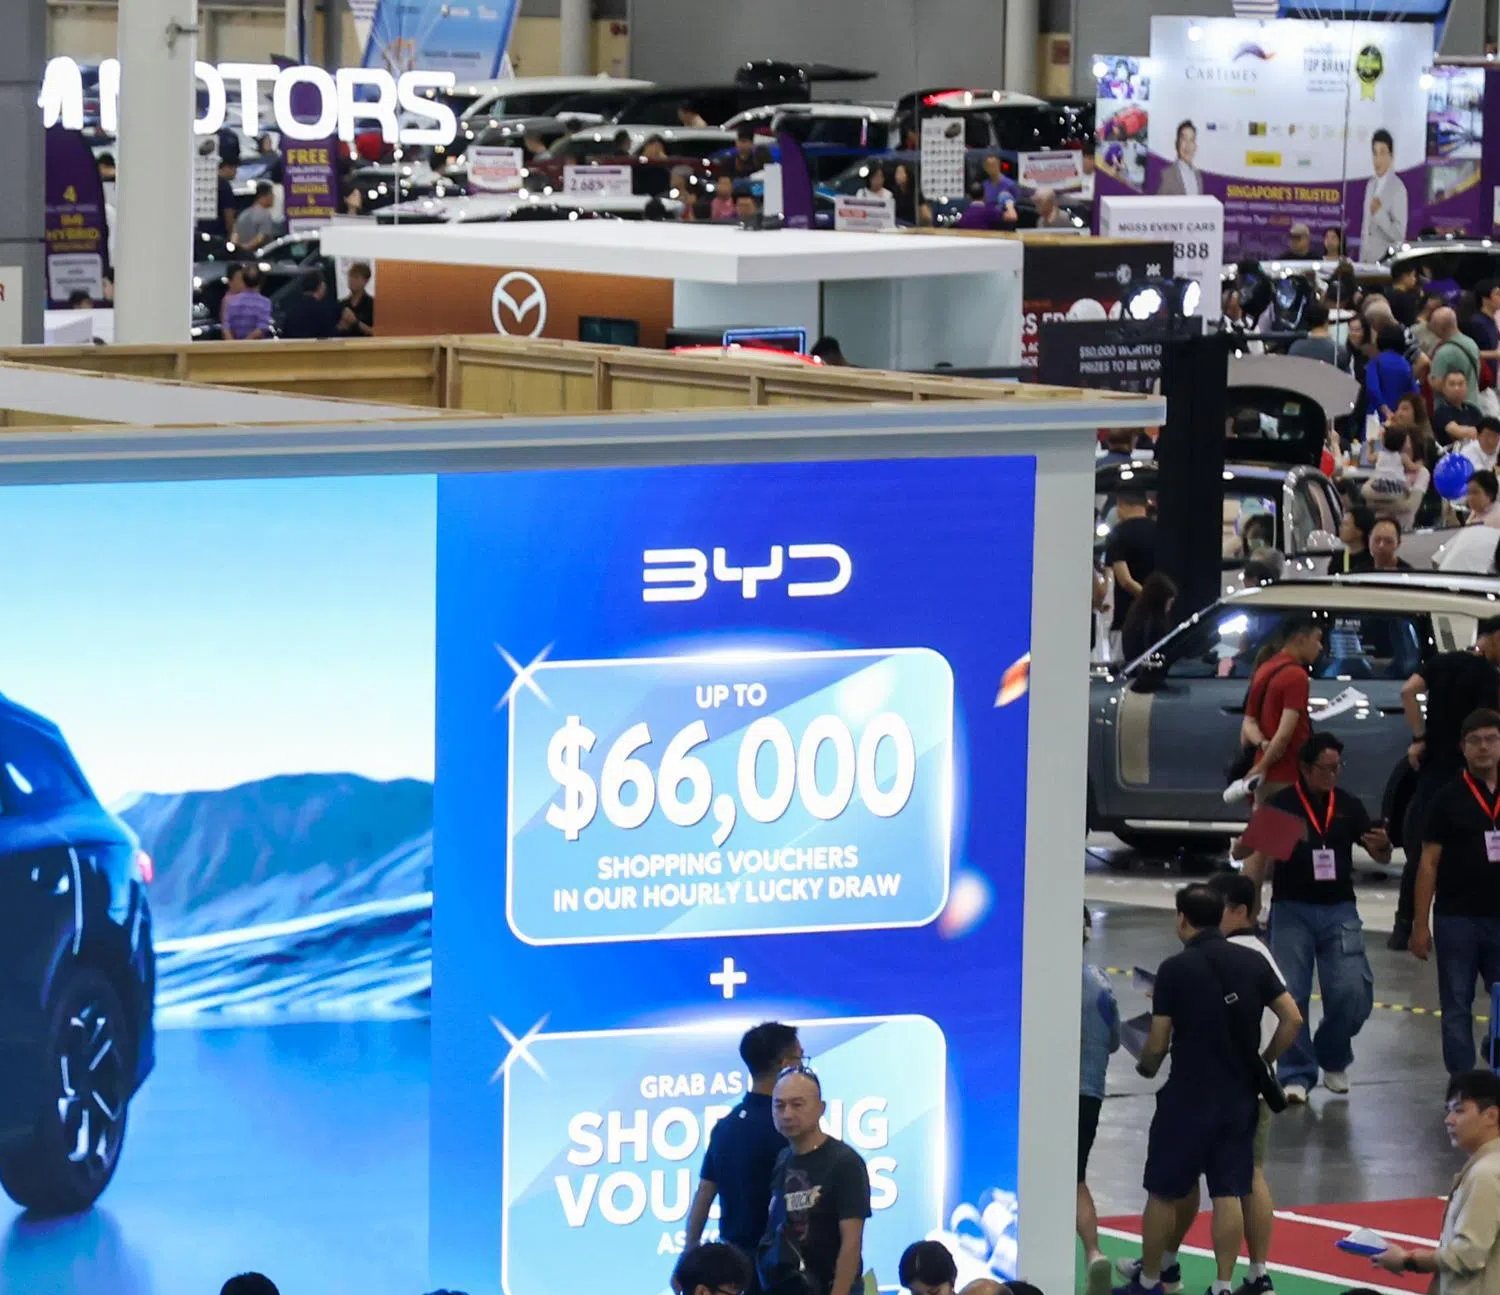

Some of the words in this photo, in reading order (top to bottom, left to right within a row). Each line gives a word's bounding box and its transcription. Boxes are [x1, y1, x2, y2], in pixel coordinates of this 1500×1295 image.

[98, 59, 458, 146] OTORS
[287, 148, 329, 165] FREE
[1294, 186, 1340, 202] TRUSTED
[1150, 222, 1189, 232] EVENT
[1191, 221, 1216, 232] CARS
[642, 543, 853, 602] BYD
[695, 684, 729, 708] UP
[734, 683, 768, 706] TO
[545, 711, 916, 847] $66,000
[597, 850, 722, 880] SHOPPING
[727, 845, 858, 873] VOUCHERS
[554, 889, 578, 912] IN
[583, 886, 637, 910] OUR
[642, 882, 742, 908] HOURLY
[745, 878, 822, 905] LUCKY
[828, 873, 901, 899] DRAW
[640, 1072, 705, 1099] GRAB
[710, 1071, 743, 1096] AS
[554, 1156, 899, 1229] VOUS
